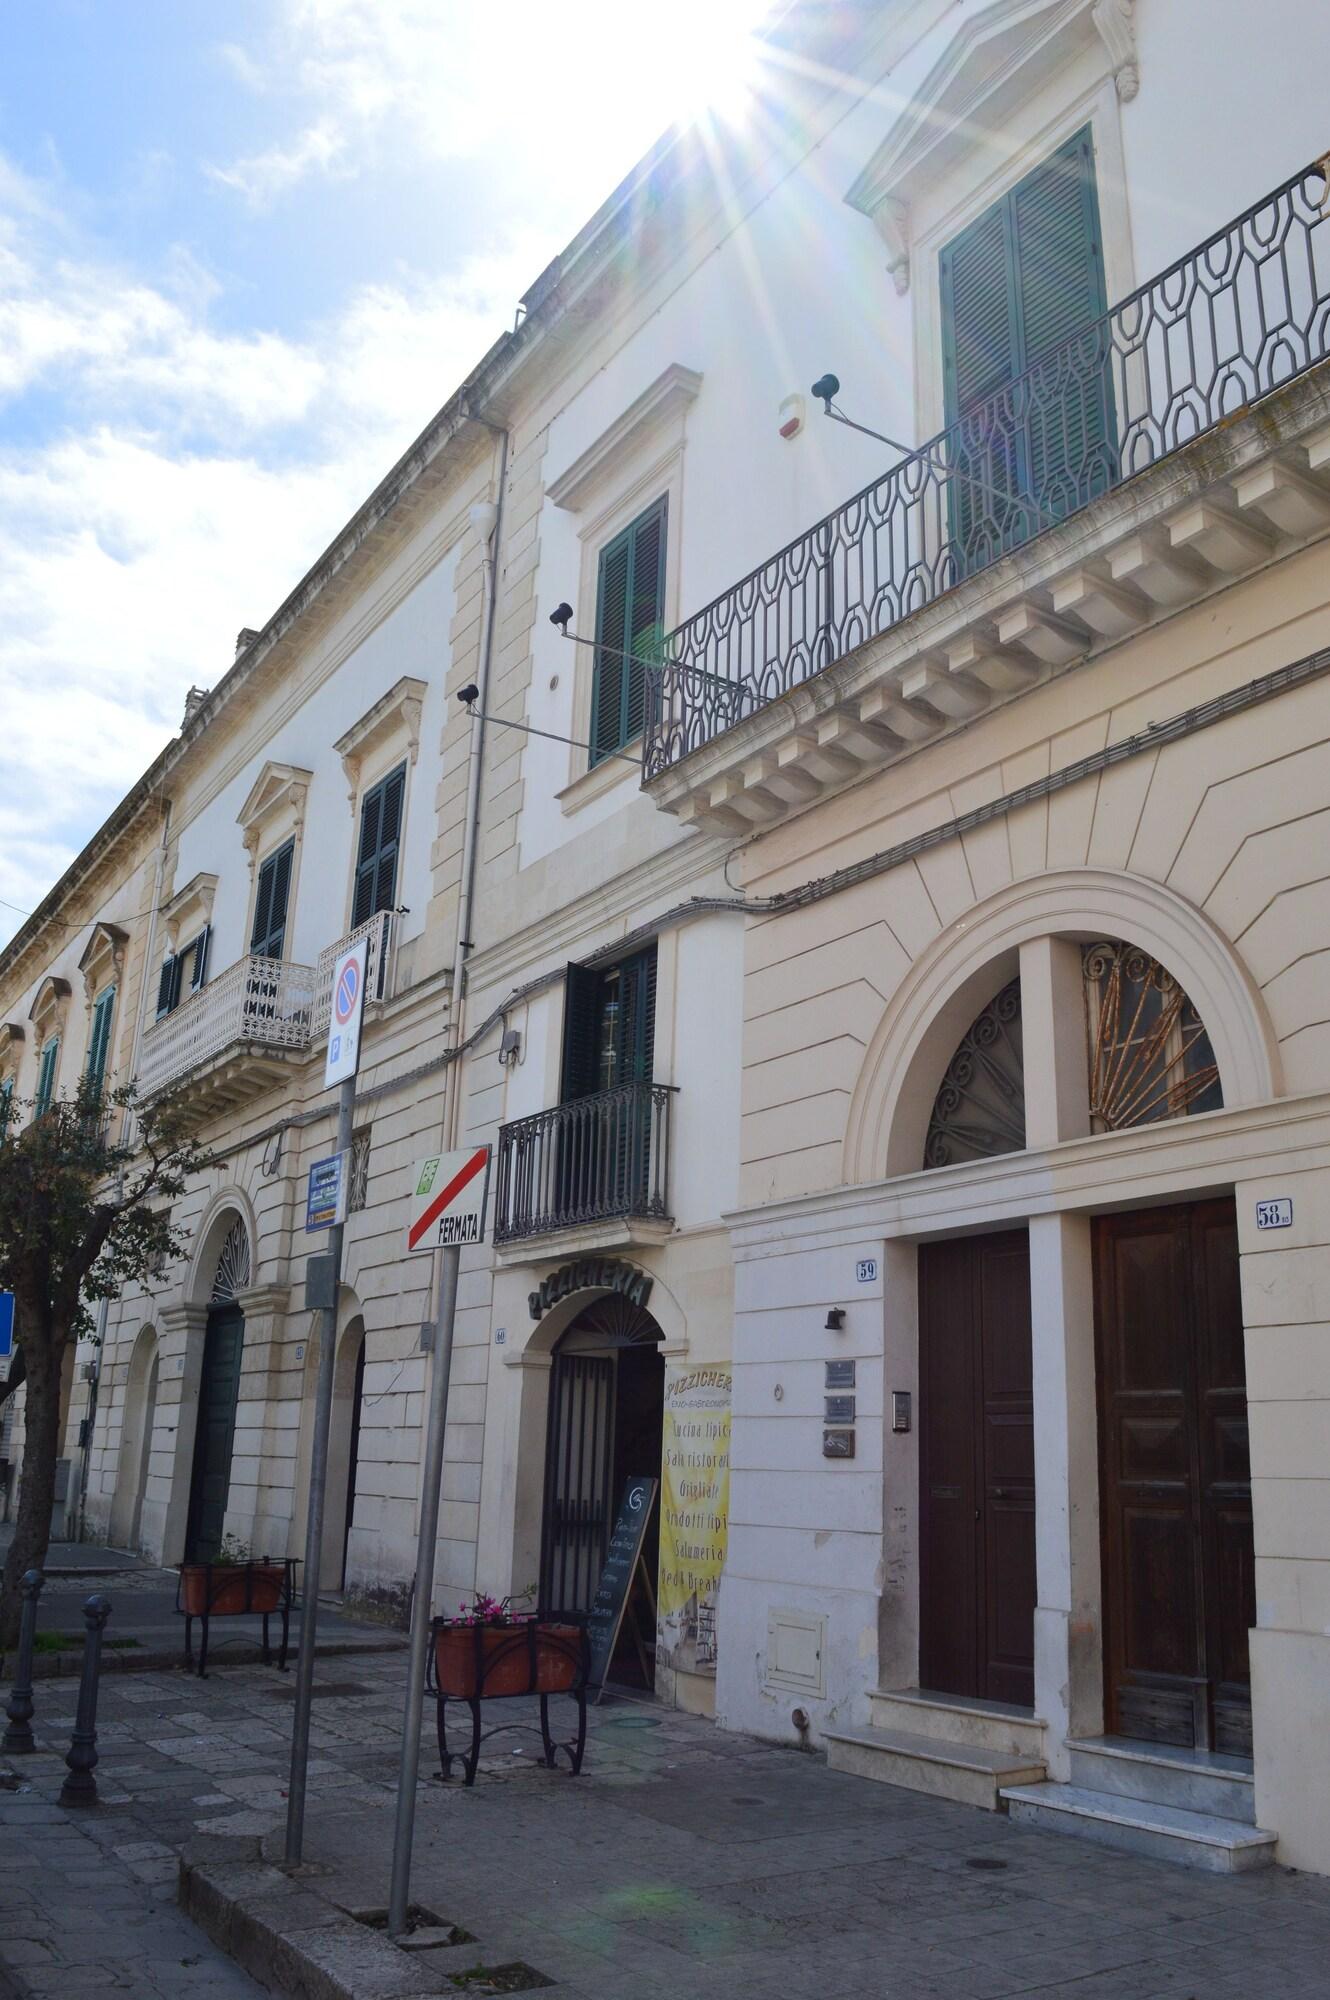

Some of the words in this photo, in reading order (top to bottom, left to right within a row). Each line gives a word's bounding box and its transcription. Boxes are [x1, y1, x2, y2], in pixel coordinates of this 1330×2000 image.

[1259, 1204, 1279, 1226] 58
[438, 1213, 478, 1244] FERMATA
[860, 1262, 874, 1279] 59
[528, 1258, 653, 1320] PIZZICHERIA
[675, 1540, 723, 1561] Salumeria
